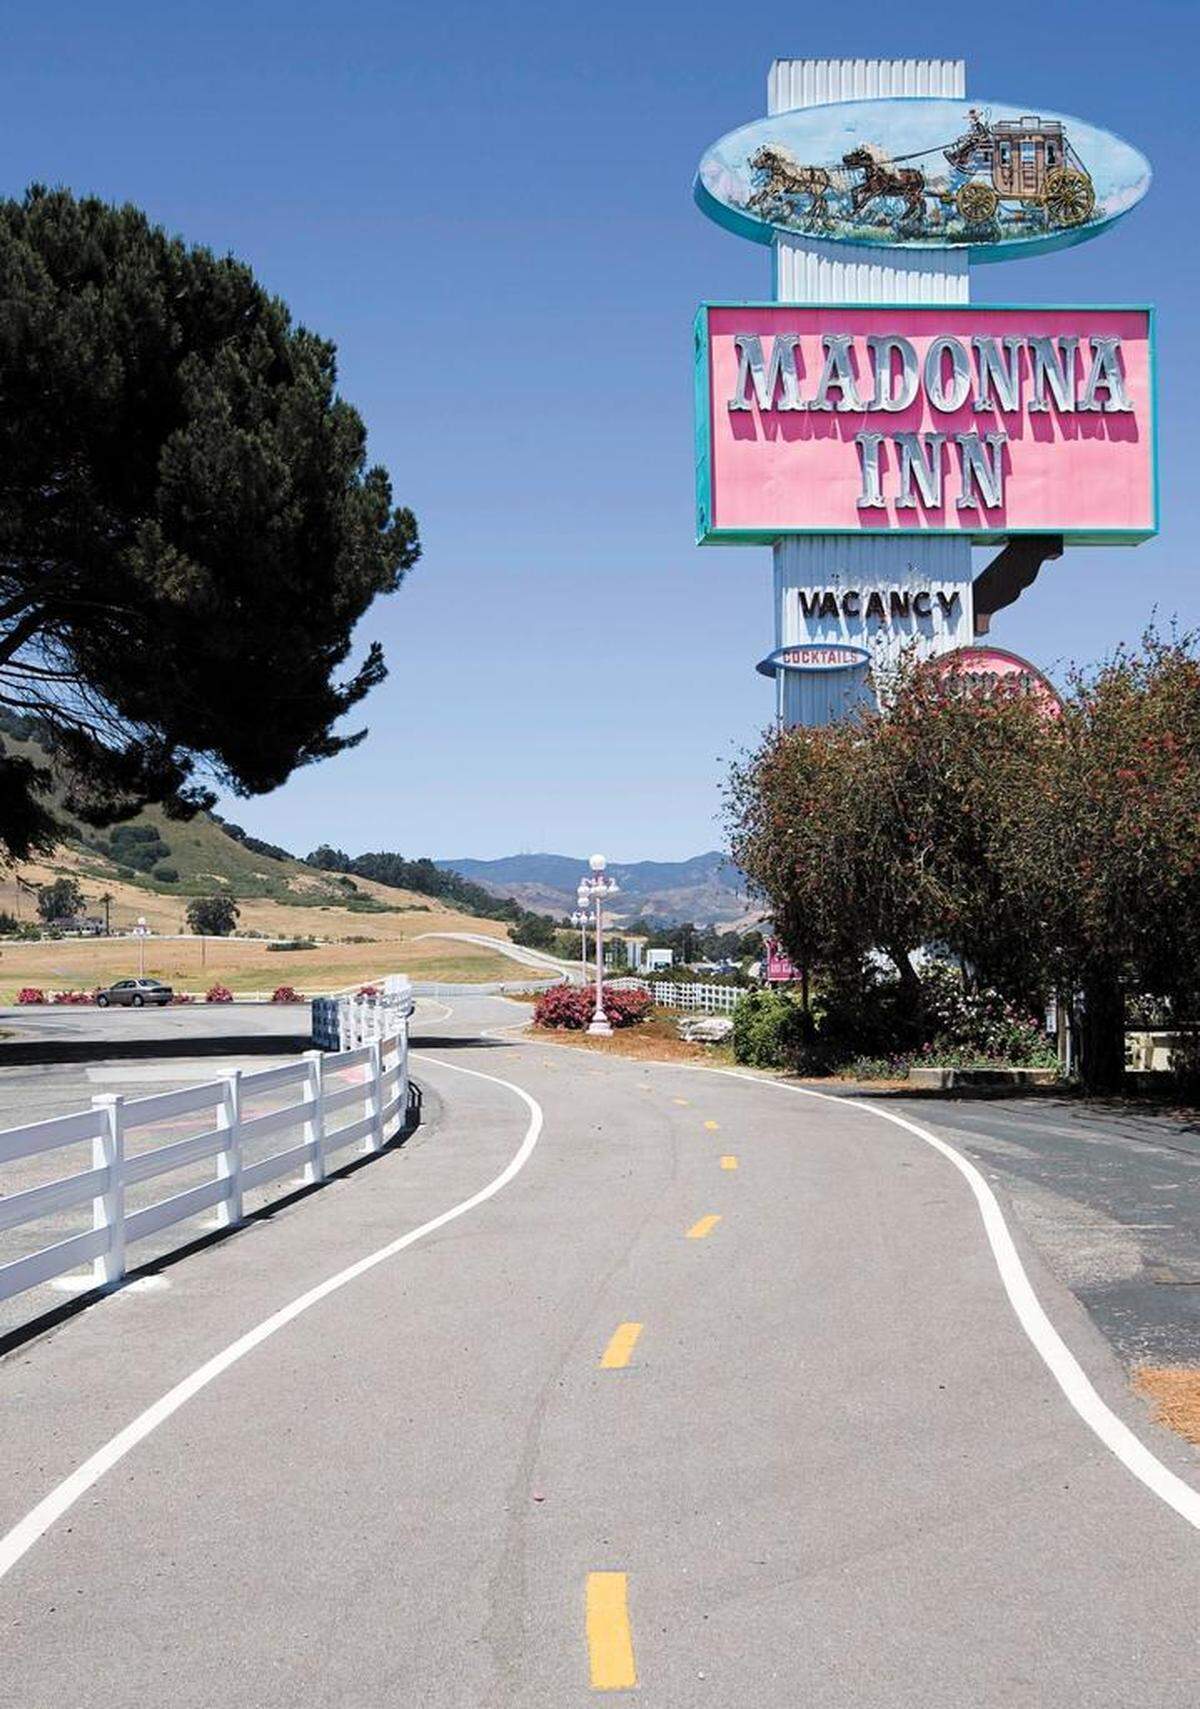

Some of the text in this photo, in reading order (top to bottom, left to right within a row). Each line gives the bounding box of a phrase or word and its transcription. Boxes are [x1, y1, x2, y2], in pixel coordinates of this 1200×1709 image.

[728, 334, 1134, 413] MADONNA
[855, 431, 1007, 509] INN
[798, 591, 960, 618] VACANCY
[783, 650, 858, 664] COCKTAILS
